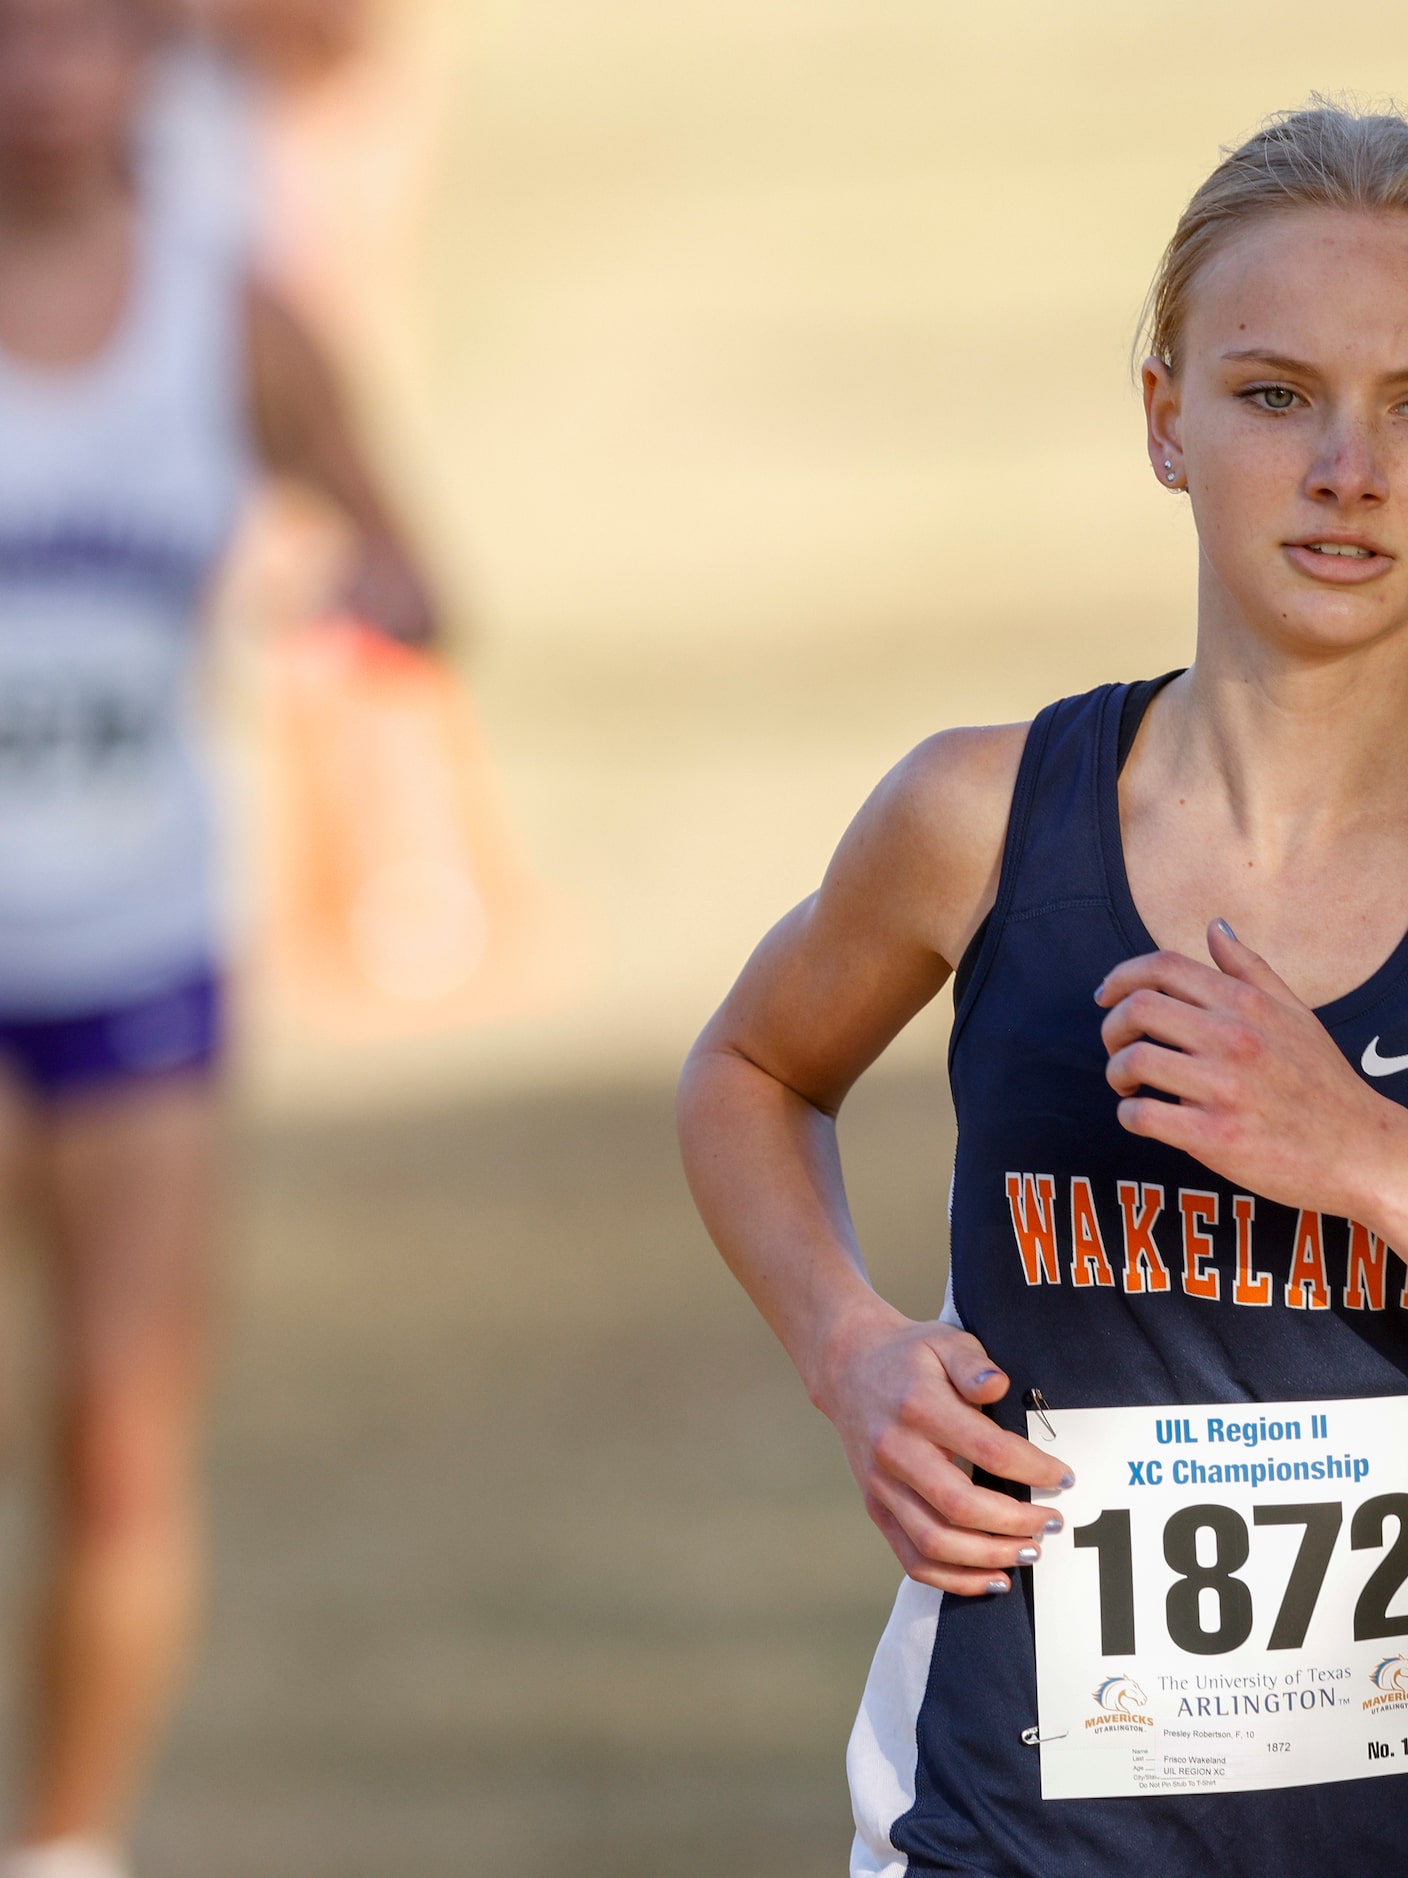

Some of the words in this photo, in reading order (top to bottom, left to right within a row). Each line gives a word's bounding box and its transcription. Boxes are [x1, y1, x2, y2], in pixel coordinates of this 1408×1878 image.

[1155, 1418, 1198, 1444] UIL
[1207, 1416, 1302, 1447] Region
[1311, 1414, 1328, 1439] II
[1127, 1460, 1163, 1486] XC
[1172, 1455, 1370, 1488] Championship
[1158, 1674, 1189, 1691] The
[1196, 1671, 1278, 1691] University
[1285, 1669, 1302, 1685] of
[1308, 1667, 1352, 1683] Texas
[1177, 1687, 1336, 1717] ARLINGTON
[1085, 1713, 1154, 1729] MAVERICKS
[1104, 1725, 1144, 1733] ARLINGTON
[1164, 1729, 1190, 1739] Presley
[1193, 1730, 1233, 1740] Robertson,
[1245, 1731, 1255, 1739] 10
[1266, 1742, 1291, 1752] 1872
[1367, 1740, 1394, 1760] No.
[1163, 1755, 1187, 1764] Frisco
[1188, 1755, 1226, 1764] Wakeland
[1163, 1767, 1176, 1775] UIL
[1178, 1767, 1212, 1776] REGION
[1213, 1767, 1225, 1776] XC
[1188, 1779, 1197, 1787] To
[1197, 1779, 1217, 1787] T-Shirt
